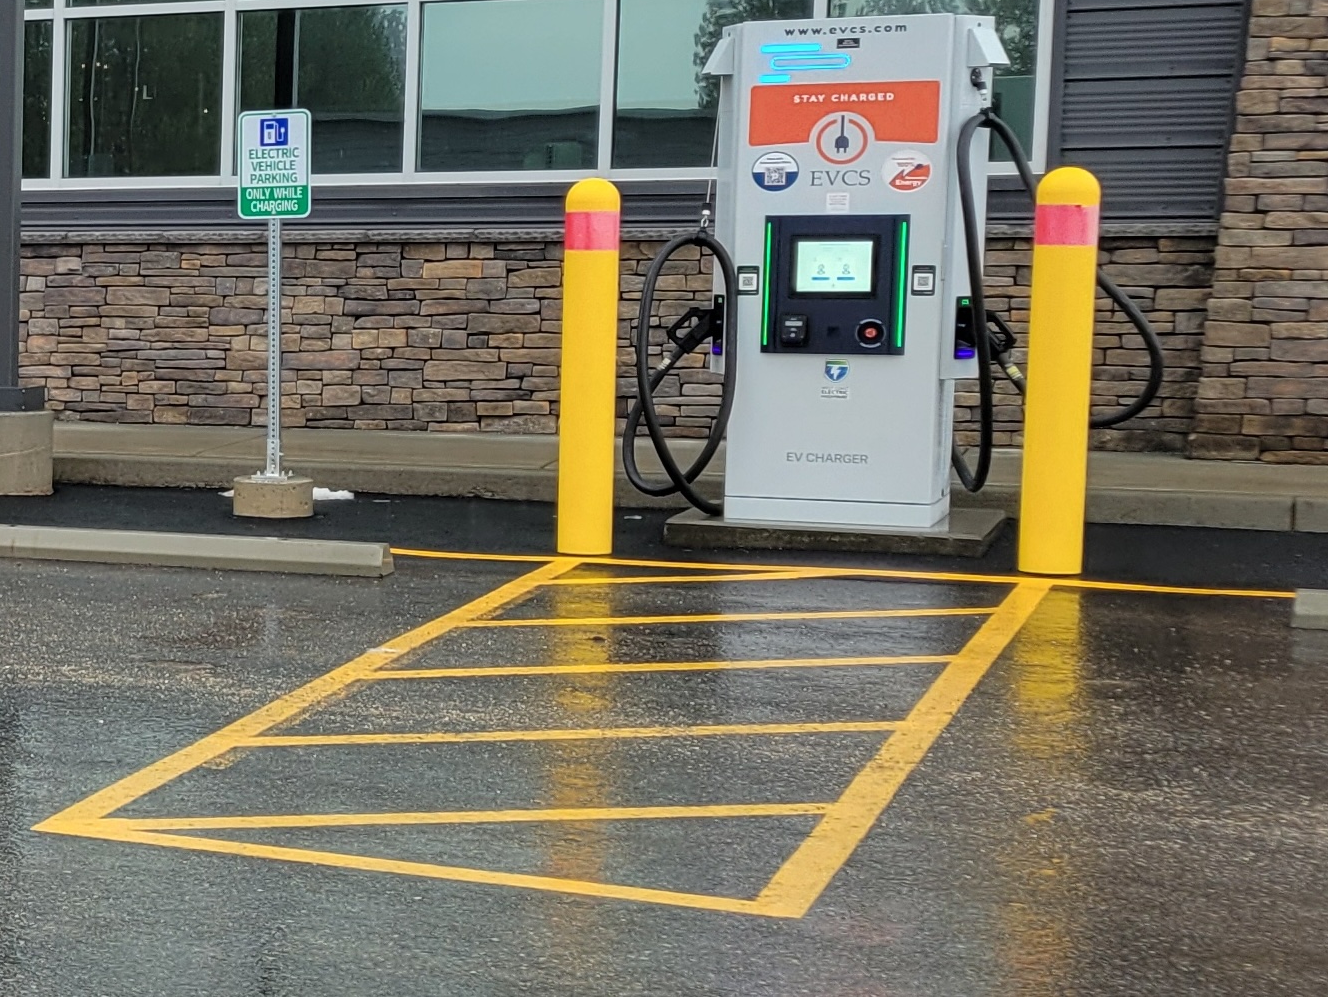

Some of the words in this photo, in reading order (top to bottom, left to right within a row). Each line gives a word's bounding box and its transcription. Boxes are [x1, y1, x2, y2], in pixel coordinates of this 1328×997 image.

[784, 24, 908, 36] www.evcs.com
[793, 94, 826, 103] STAY
[831, 92, 895, 102] CHARGED
[249, 147, 300, 160] ELECTRIC
[251, 160, 296, 172] VEHICLE
[250, 172, 298, 184] PARKING
[809, 169, 872, 187] EVCS
[246, 188, 271, 200] ONLY
[273, 187, 303, 199] WHILE
[250, 200, 298, 212] CHARGING
[786, 452, 803, 462] EV
[806, 452, 869, 464] CHARGER
